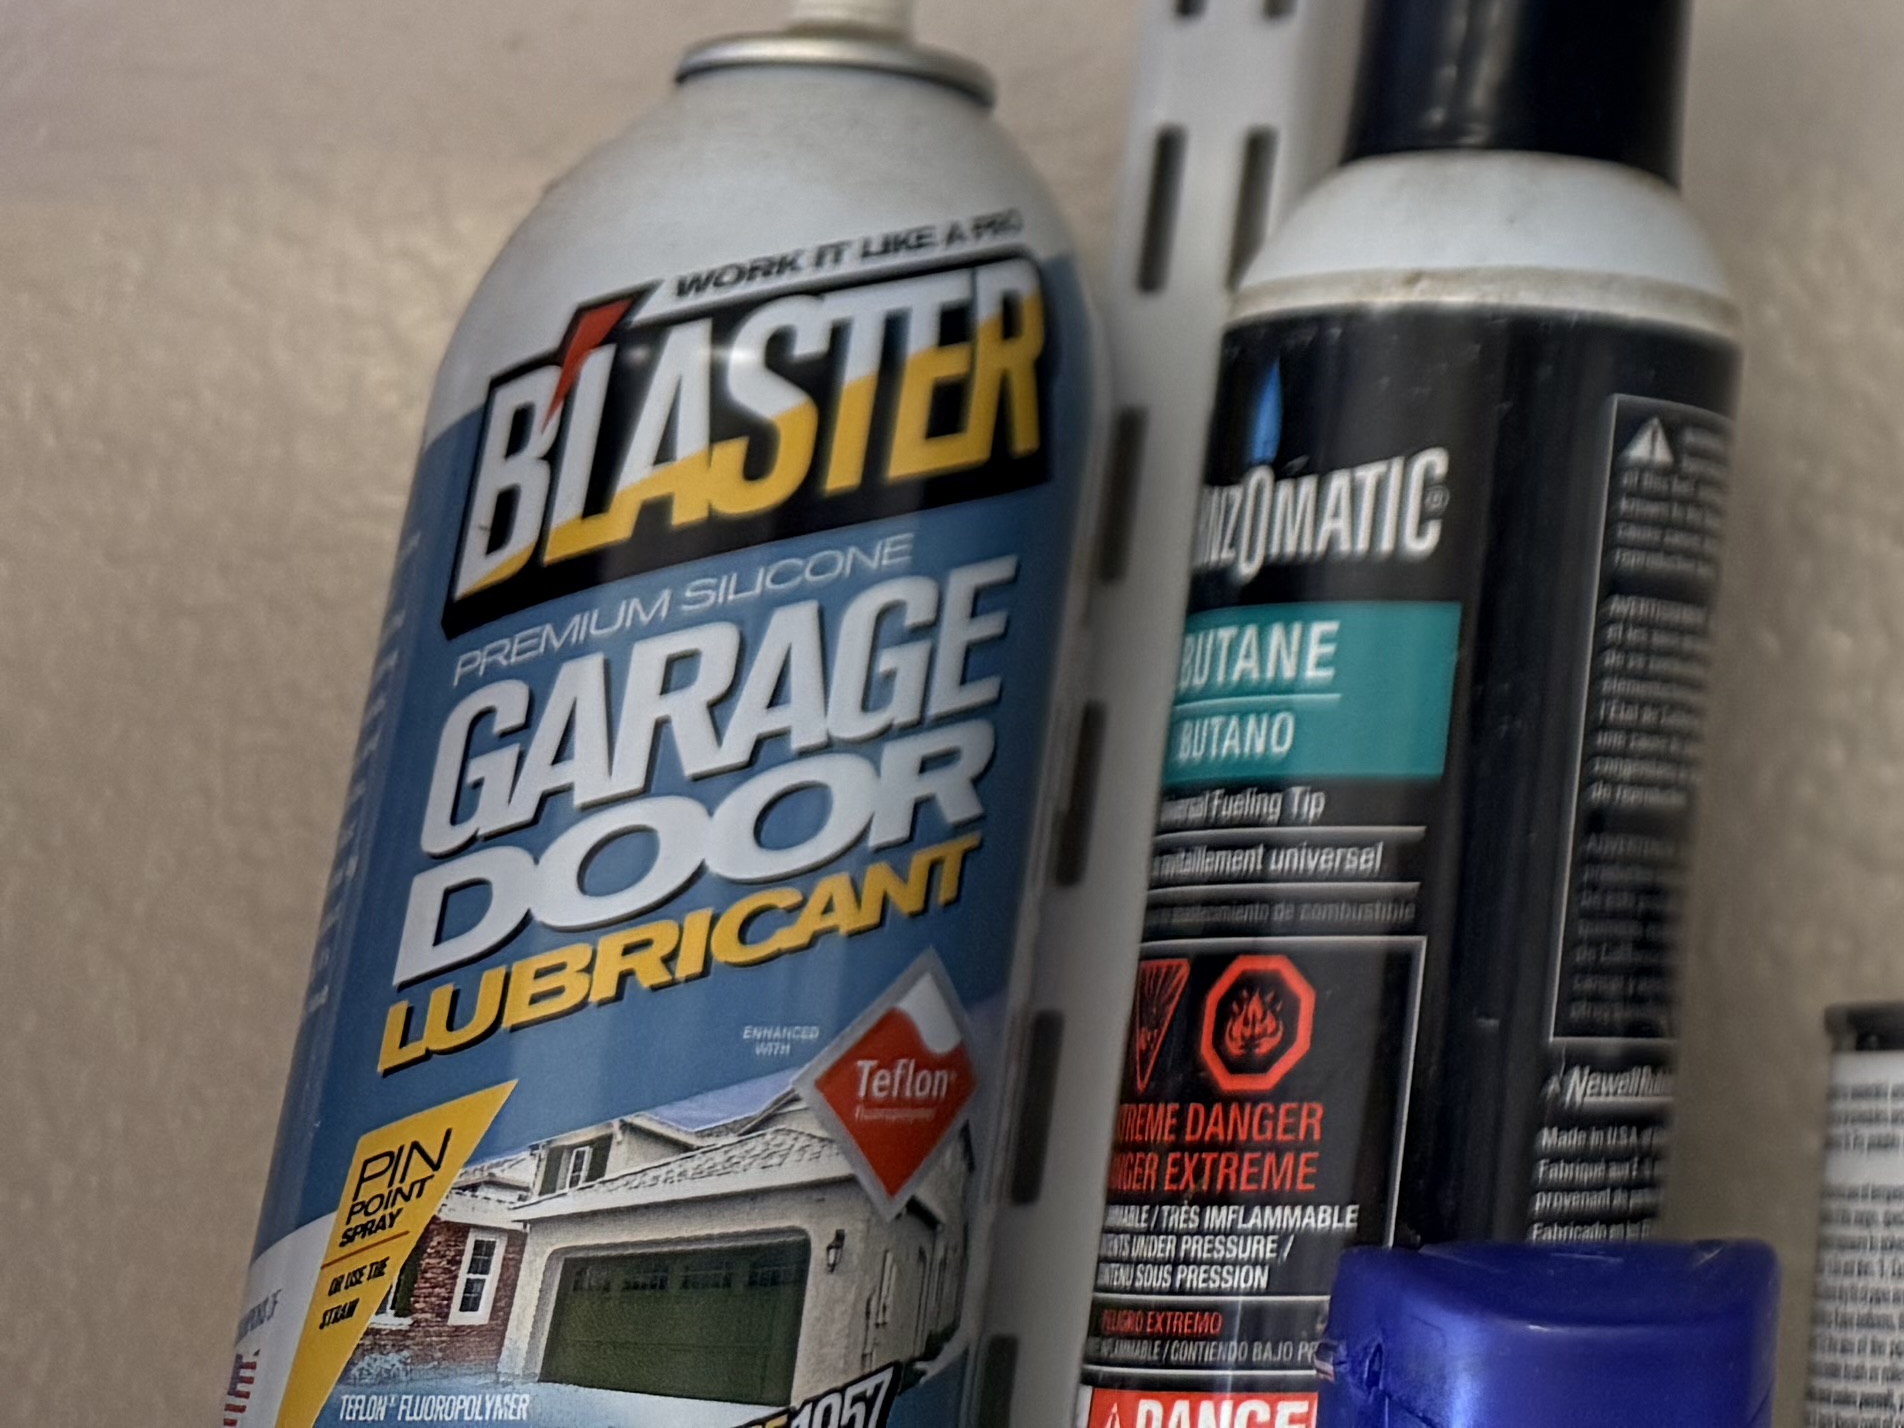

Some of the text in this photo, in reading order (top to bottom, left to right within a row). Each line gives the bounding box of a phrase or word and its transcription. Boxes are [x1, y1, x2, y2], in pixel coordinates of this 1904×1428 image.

[674, 248, 805, 299] WORK
[809, 240, 850, 272] IT
[858, 228, 938, 260] LIKE
[453, 532, 915, 687] PREMIUM SILICONE
[1177, 620, 1341, 690] BUTANE
[420, 554, 1019, 858] GARAGE
[1177, 710, 1295, 764] BUTANO
[1211, 788, 1282, 823] Fueling
[1289, 786, 1326, 822] Tip
[393, 719, 996, 989] DOOR
[1270, 841, 1383, 876] universel
[377, 832, 982, 1076] LUBRICANT
[742, 1025, 819, 1042] ENHANCED
[1185, 1102, 1325, 1142] DANGER
[352, 1126, 453, 1202] PIN
[1164, 1152, 1320, 1191] EXTREME
[345, 1174, 436, 1226] POINT
[1204, 1204, 1360, 1230] IMFLAMMABLE
[339, 1208, 402, 1248] SPRAY
[1132, 1235, 1279, 1259] UNDER PRESSURE
[1136, 1265, 1270, 1290] SOUS PRESSION
[319, 1298, 360, 1330] STRAW
[1147, 1311, 1223, 1334] EXTREMO
[1169, 1341, 1293, 1361] CONTIENDO BAJO
[398, 1393, 530, 1421] FLUOROPOLYMER
